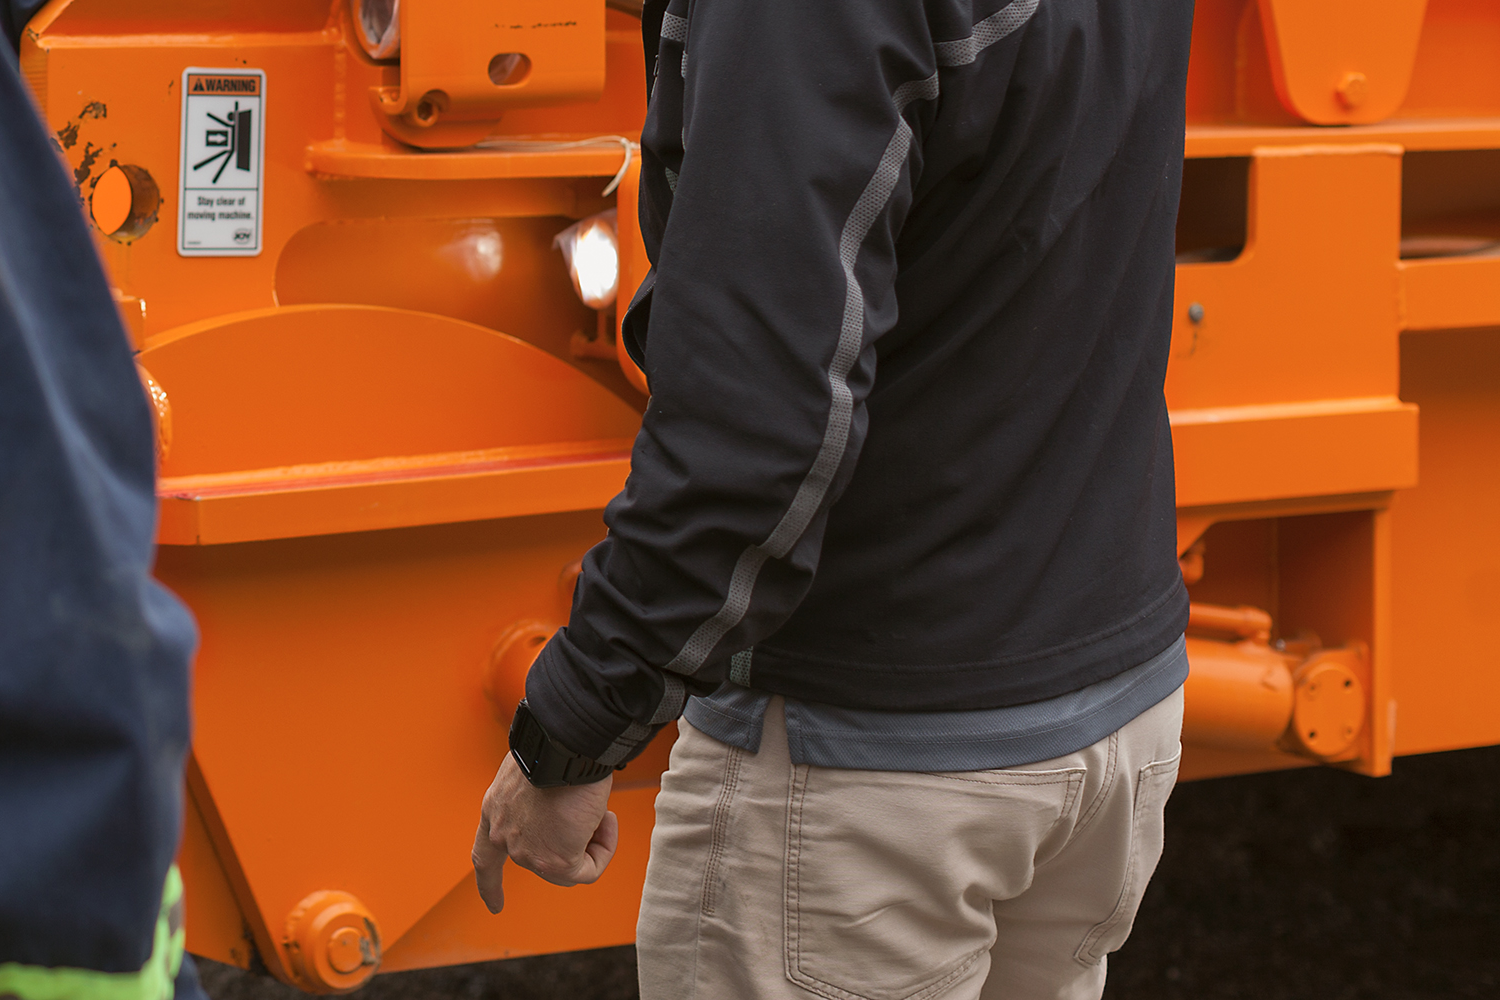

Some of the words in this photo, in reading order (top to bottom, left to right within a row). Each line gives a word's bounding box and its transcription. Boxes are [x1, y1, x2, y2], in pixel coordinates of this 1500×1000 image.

[205, 78, 256, 92] WARNING
[197, 196, 214, 207] Stay
[216, 196, 235, 206] clear
[237, 196, 246, 206] of
[187, 211, 215, 221] moving
